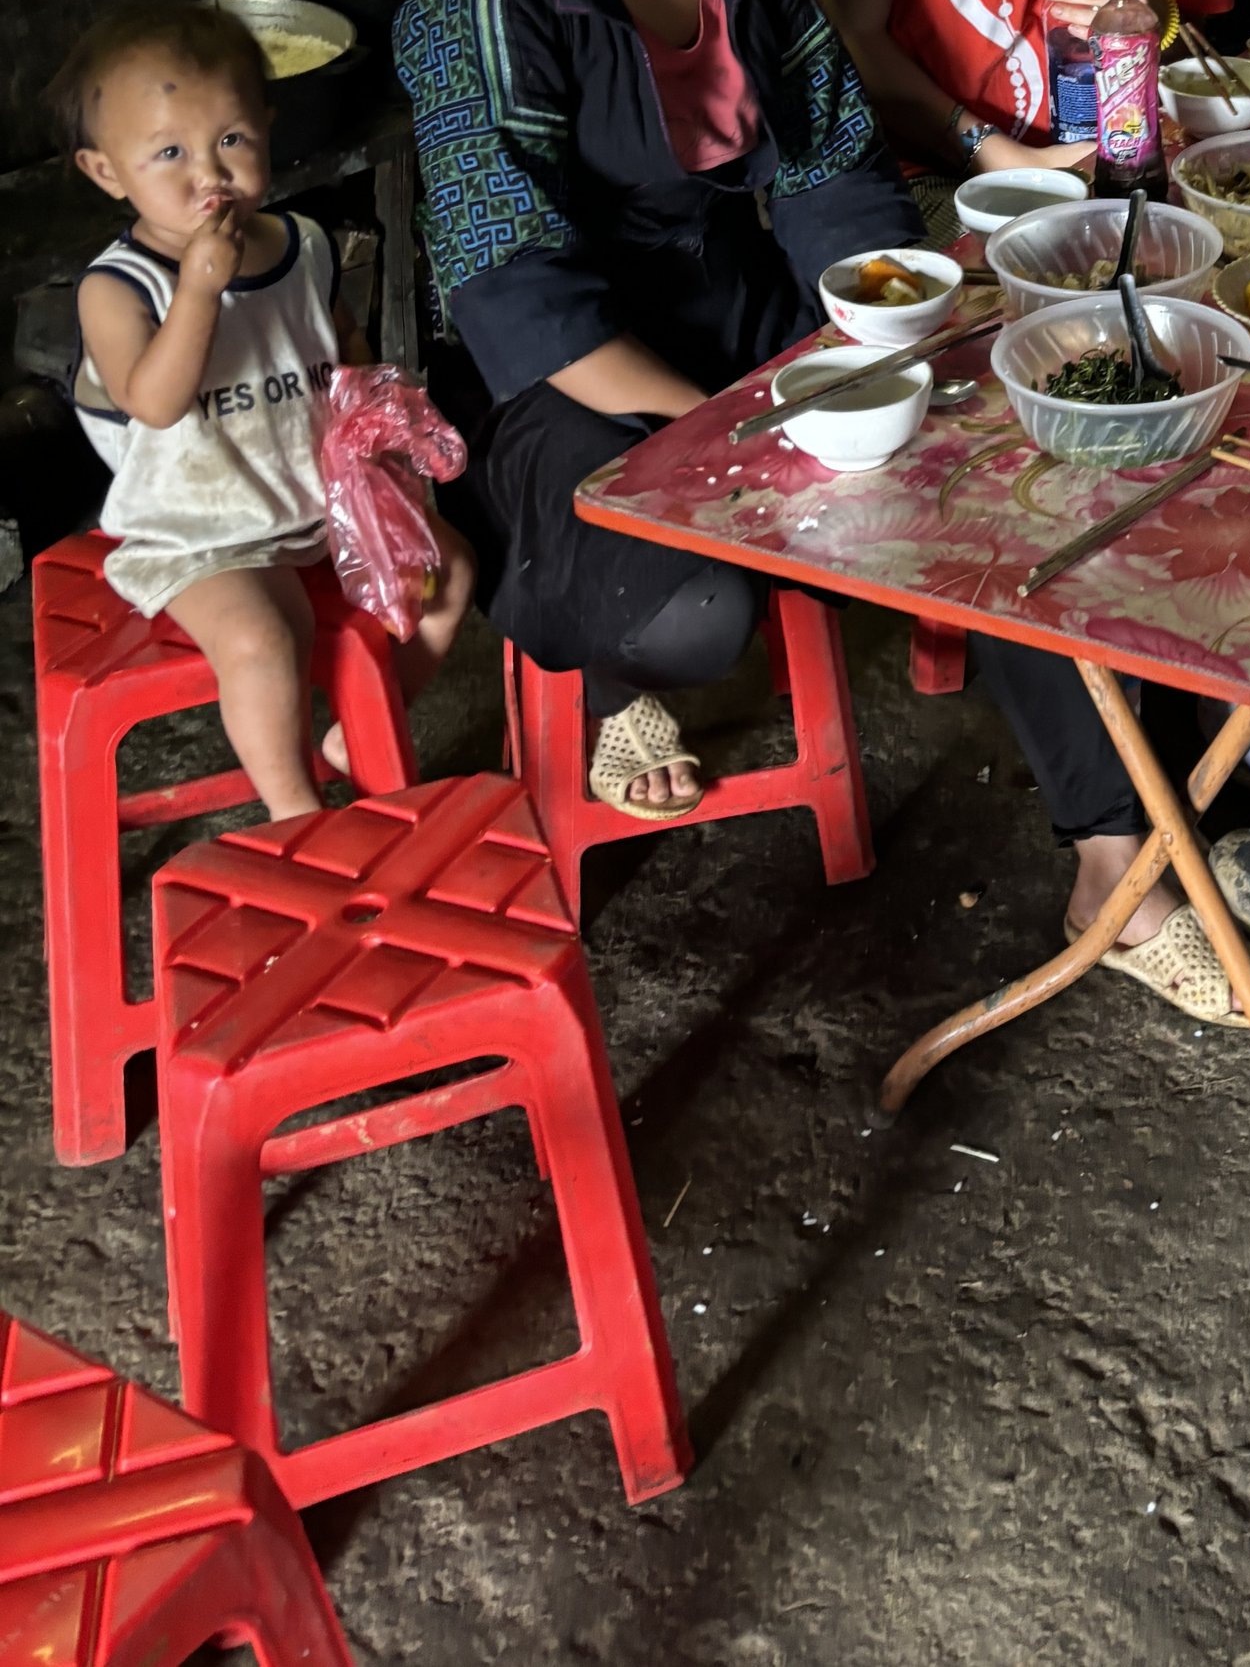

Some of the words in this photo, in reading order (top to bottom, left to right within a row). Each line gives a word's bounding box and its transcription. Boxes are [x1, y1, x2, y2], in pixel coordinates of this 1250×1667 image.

[1109, 137, 1141, 149] PEACH
[196, 382, 255, 421] YES
[264, 371, 304, 404] OR
[306, 361, 334, 393] NO
